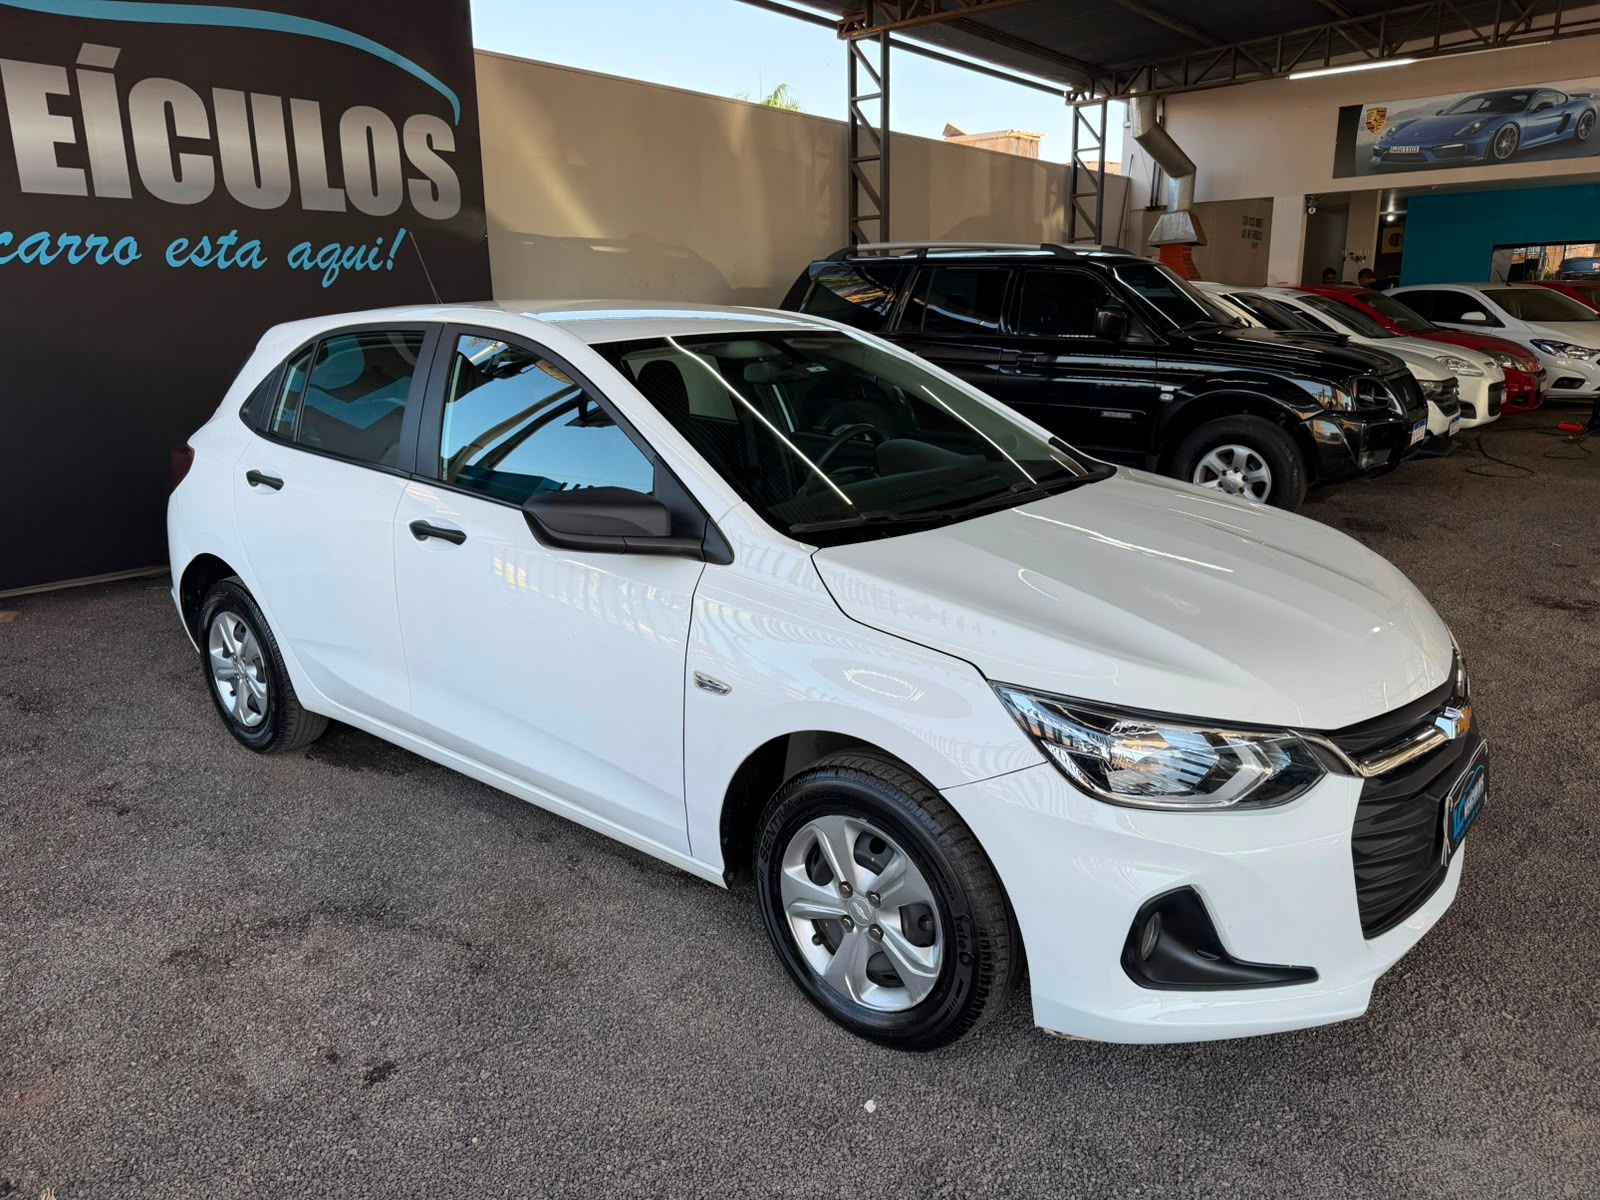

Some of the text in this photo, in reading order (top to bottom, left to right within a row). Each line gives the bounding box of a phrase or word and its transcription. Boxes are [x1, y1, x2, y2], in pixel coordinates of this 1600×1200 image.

[0, 228, 406, 288] carro esta aqui!
